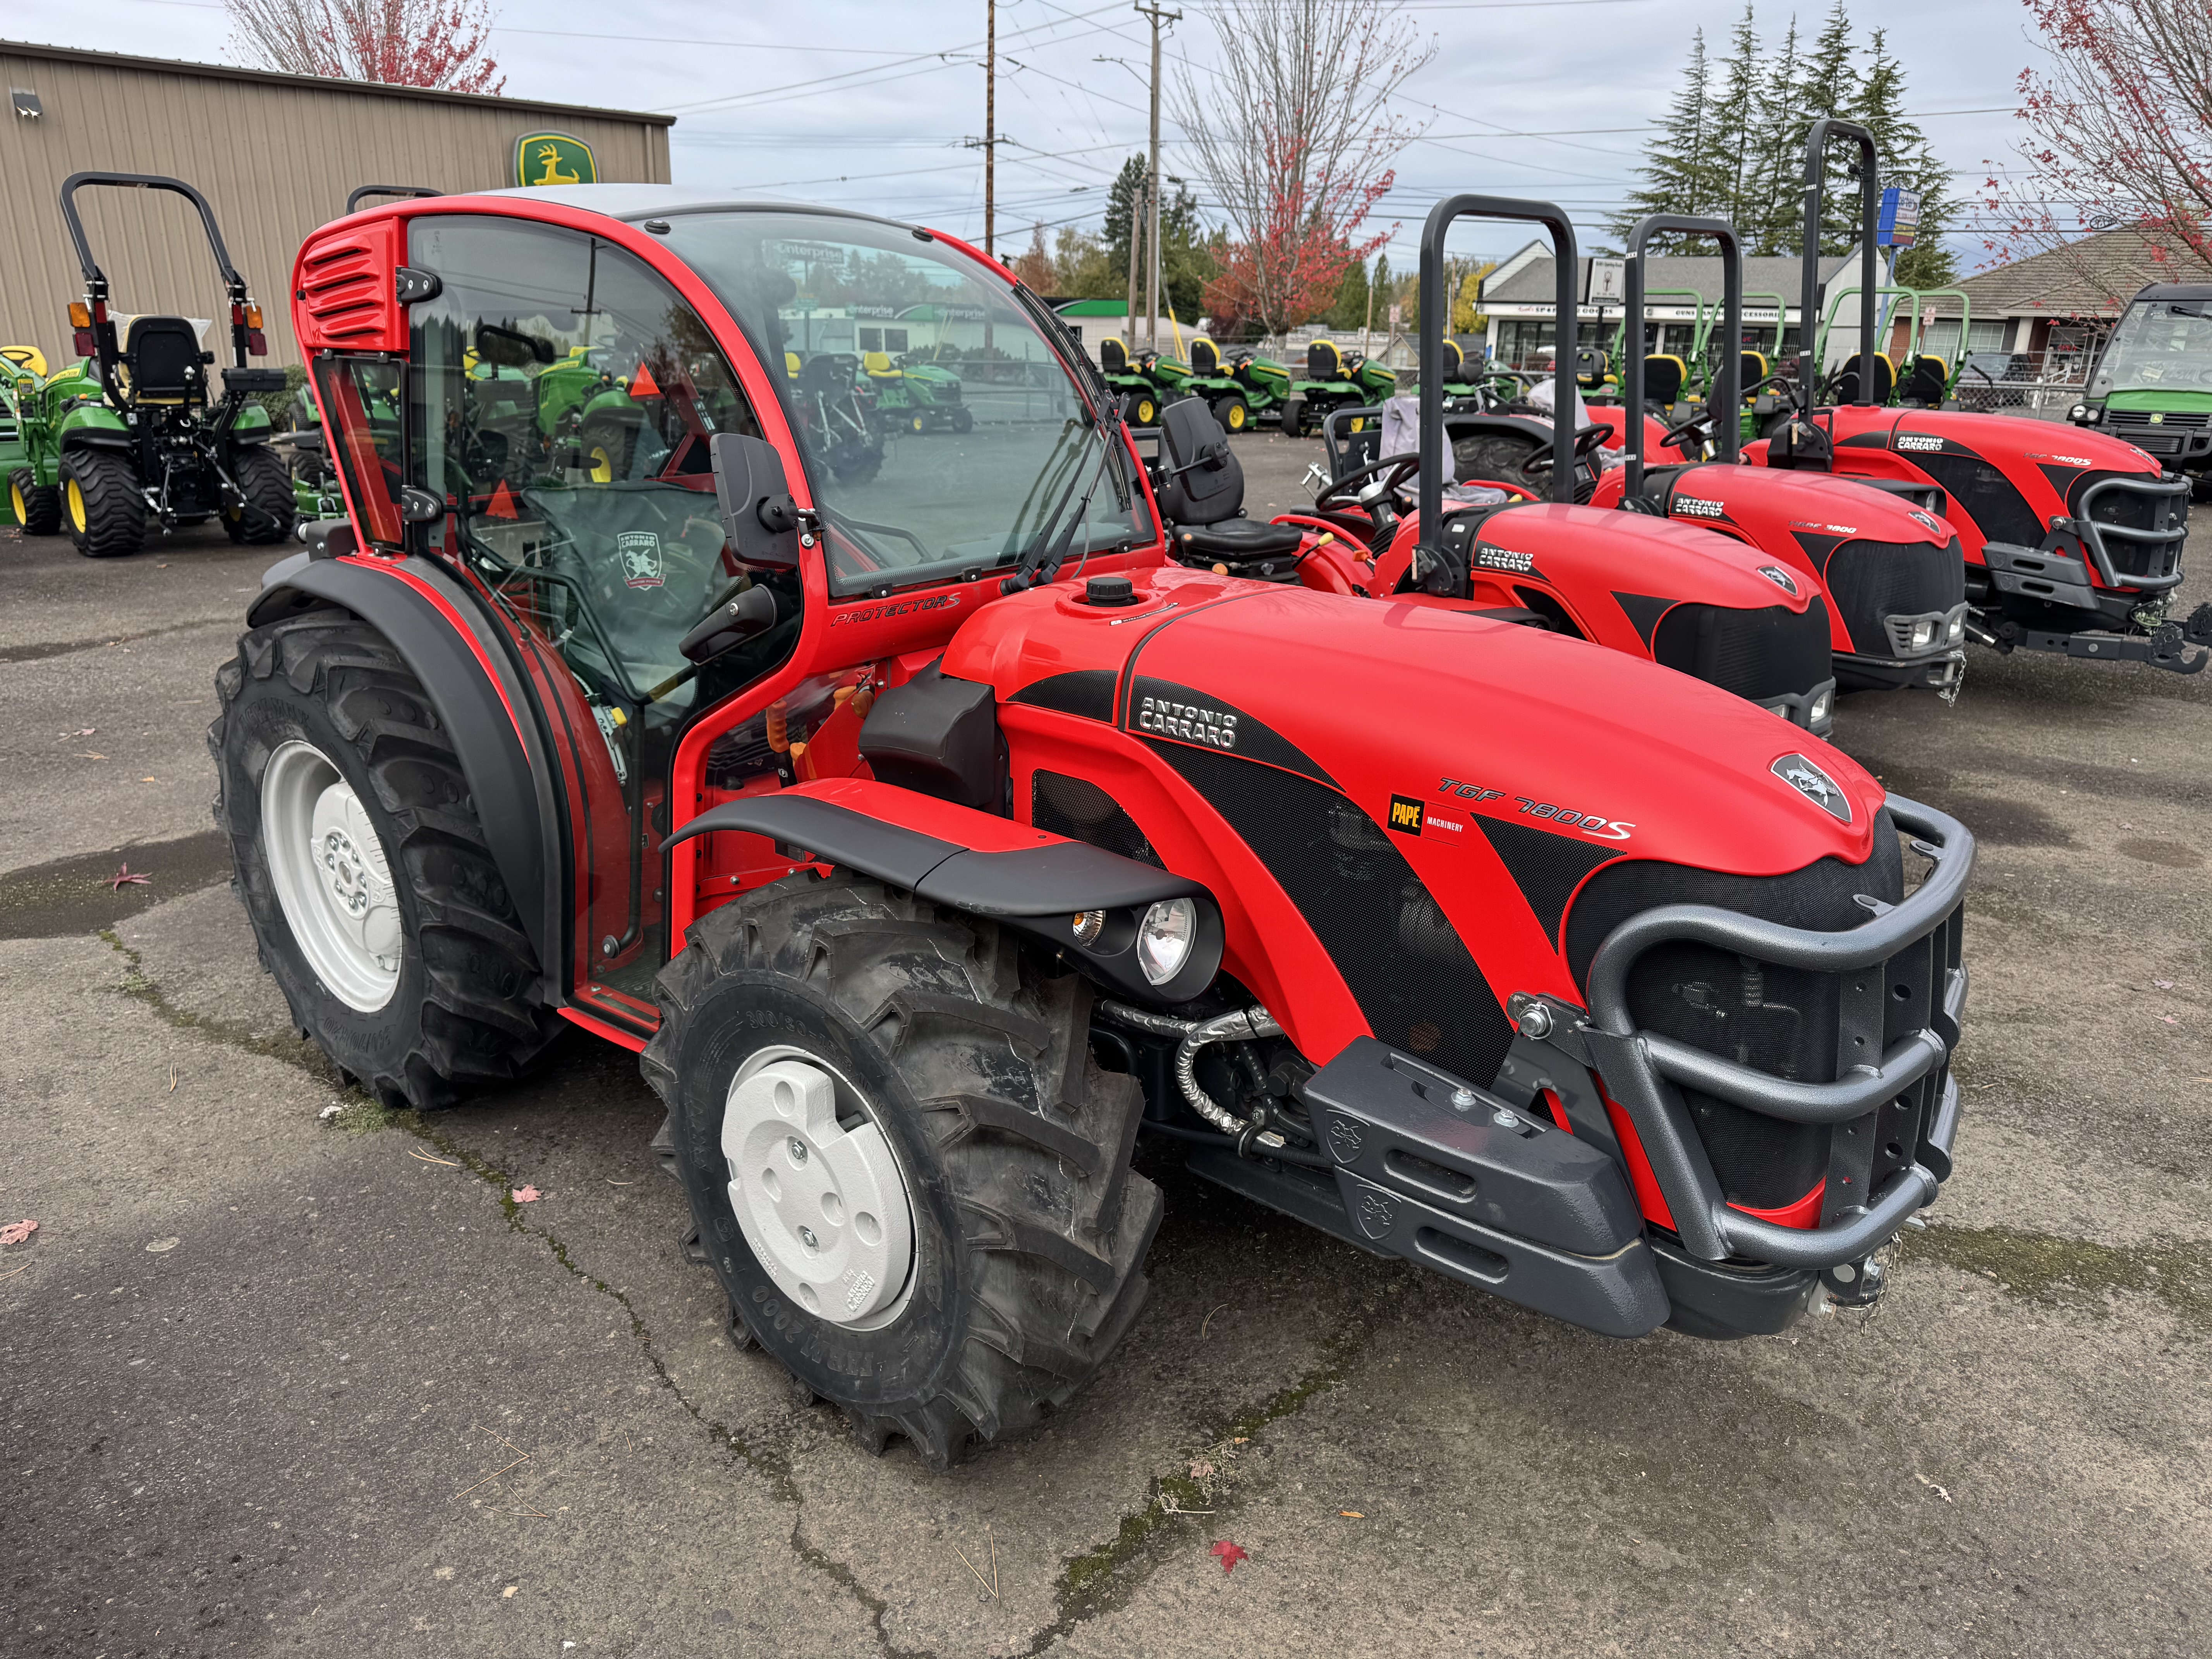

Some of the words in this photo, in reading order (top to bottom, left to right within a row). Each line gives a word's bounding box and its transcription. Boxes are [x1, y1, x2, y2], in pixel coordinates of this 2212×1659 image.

[1898, 441, 1942, 451] CARRARO
[1675, 503, 1723, 517] CARRARO
[1676, 498, 1724, 507] ANTONIO
[622, 539, 655, 548] CARRARO
[1480, 547, 1534, 560] ANTONIO
[1479, 554, 1532, 572] CARRARO
[1142, 697, 1237, 728] ANTONIO
[1140, 711, 1235, 749] CARRARO
[1437, 777, 1506, 802] TGF
[1513, 796, 1637, 840] 7800S
[1427, 816, 1463, 833] MACHINERY
[751, 1285, 805, 1344] 2000
